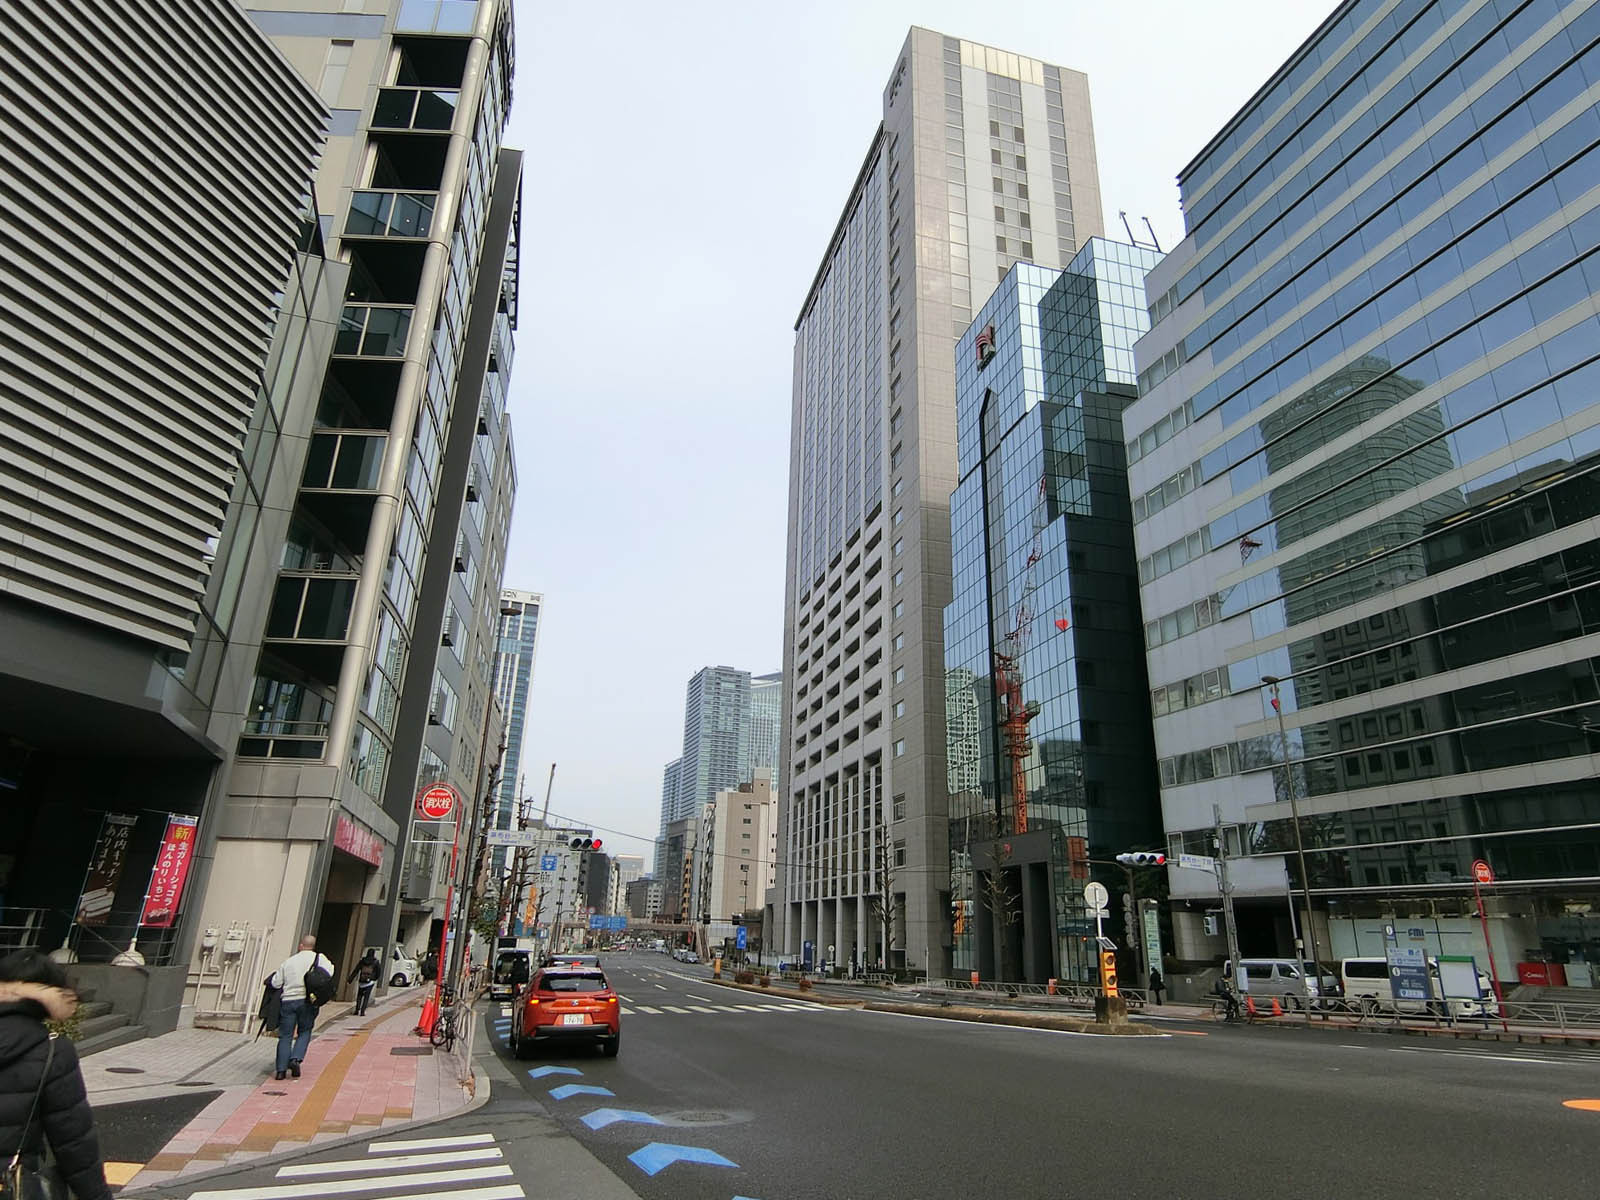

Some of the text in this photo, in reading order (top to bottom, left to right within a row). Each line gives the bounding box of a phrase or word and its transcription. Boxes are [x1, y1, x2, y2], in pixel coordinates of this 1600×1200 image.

[425, 797, 451, 808] 消火栓
[105, 825, 129, 887] 店内キッチン
[152, 843, 176, 902] ほんのりいちご
[164, 841, 189, 907] 生ガトーショコラ
